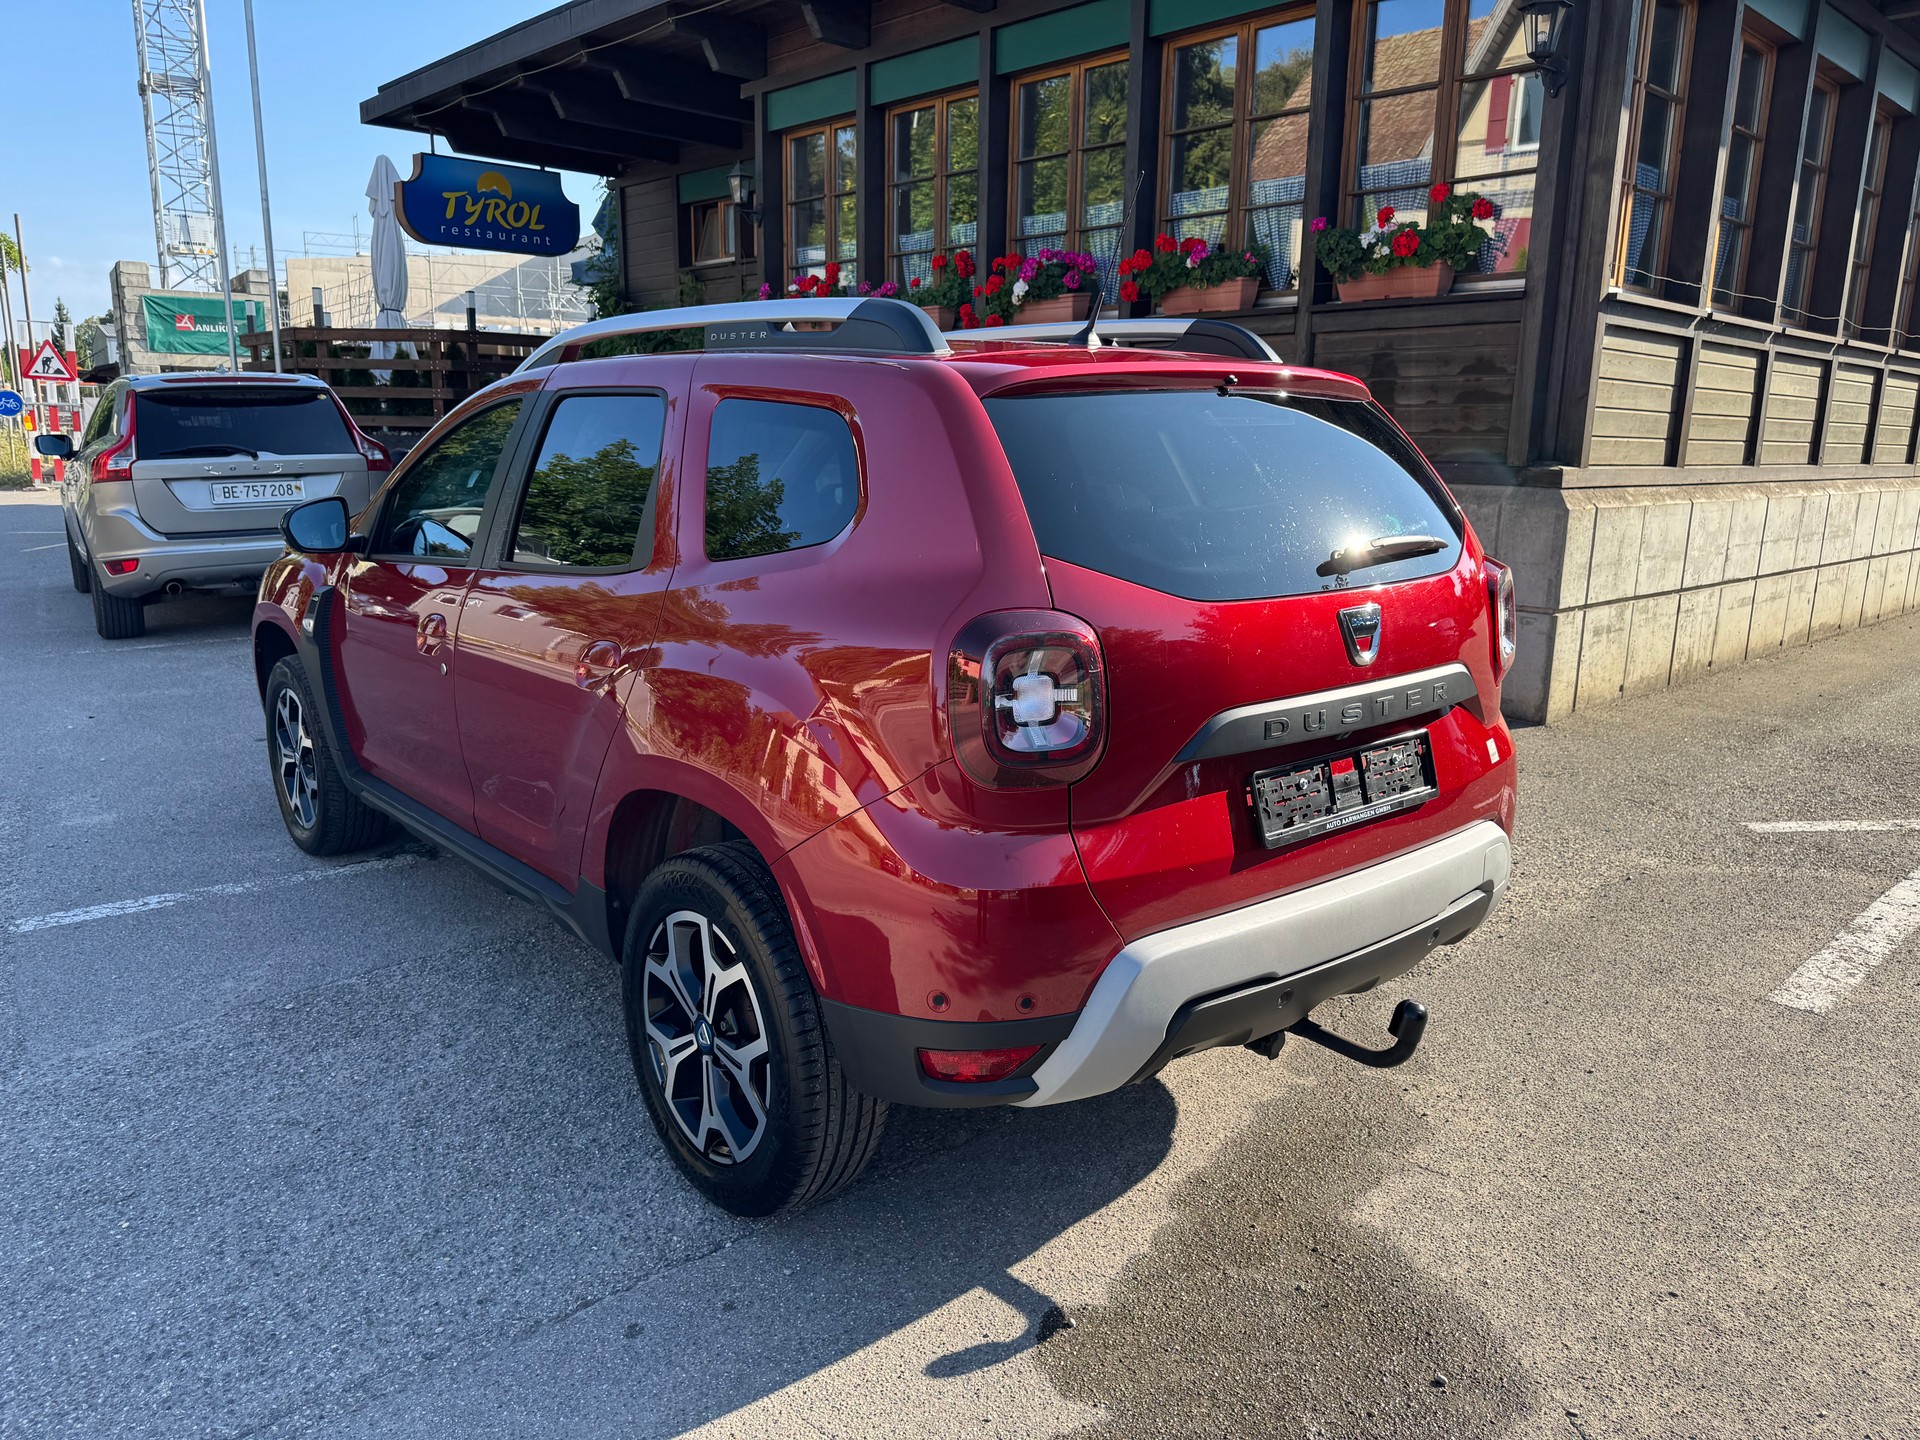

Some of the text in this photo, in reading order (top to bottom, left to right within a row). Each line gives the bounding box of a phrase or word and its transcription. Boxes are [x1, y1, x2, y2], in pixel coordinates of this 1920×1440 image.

[442, 191, 545, 230] TYROL
[440, 225, 551, 246] restaurant
[195, 324, 239, 333] ANLIKR
[710, 331, 767, 341] DUSTER
[1264, 682, 1448, 740] DUSTER
[1326, 820, 1341, 829] AUTO
[1341, 809, 1375, 824] AARWANGEN
